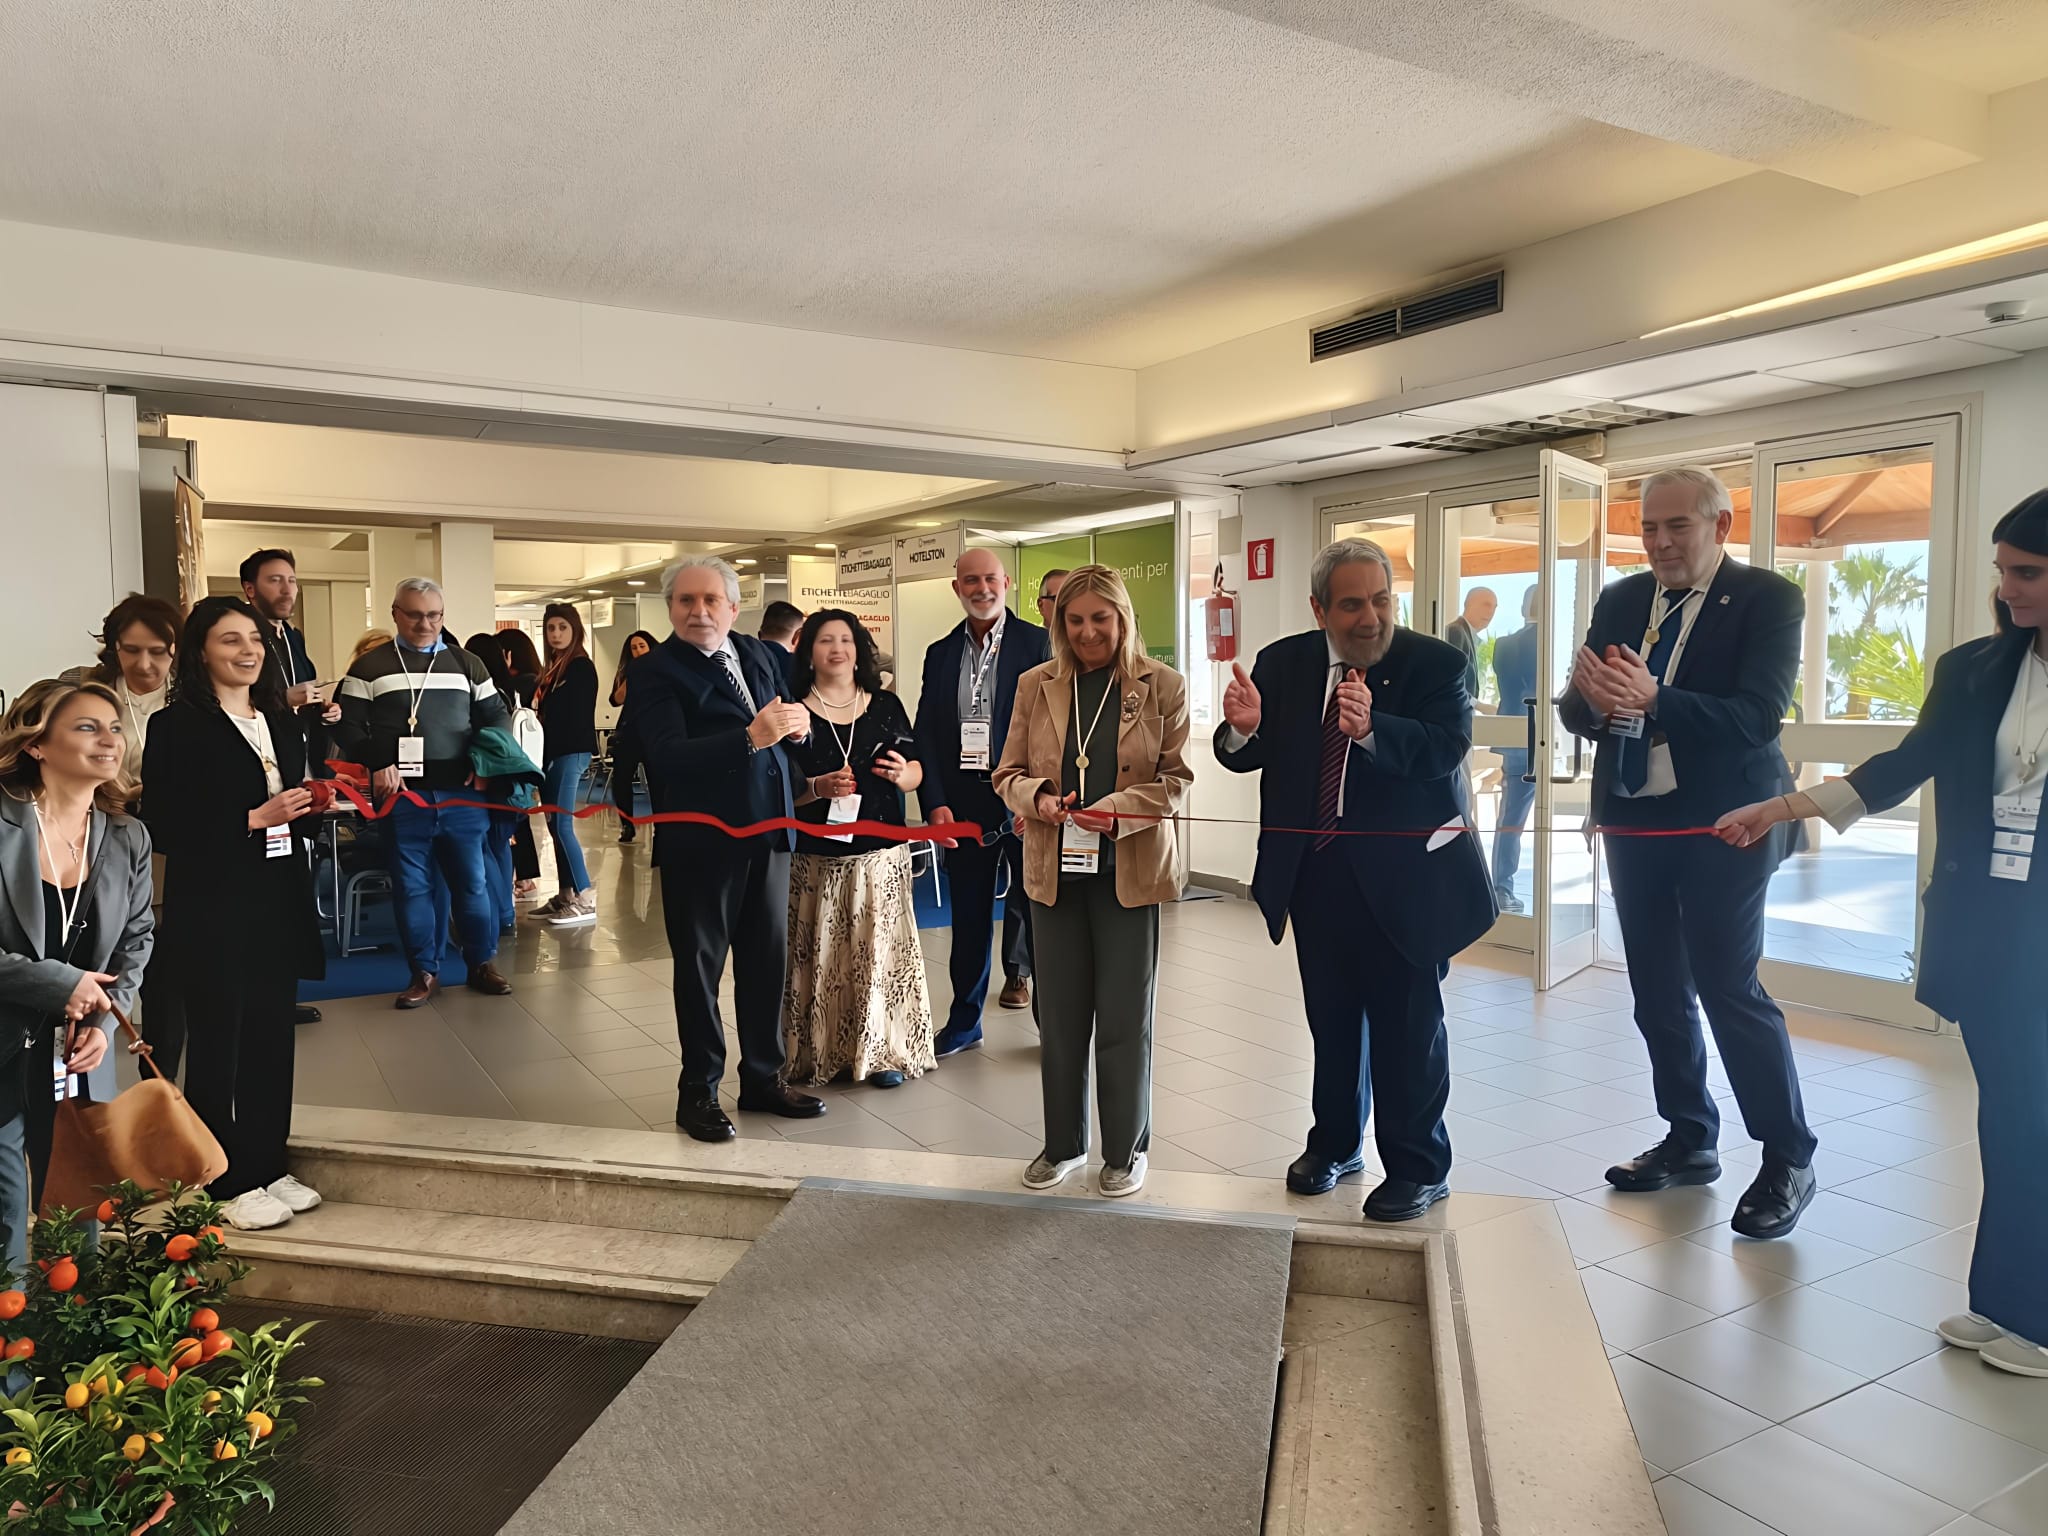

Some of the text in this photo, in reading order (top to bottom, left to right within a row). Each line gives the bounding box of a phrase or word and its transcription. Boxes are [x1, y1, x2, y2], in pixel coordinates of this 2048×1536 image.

[909, 548, 945, 564] HOTELSTON
[841, 557, 892, 574] ETICHETTEBAGAGLIO
[1147, 562, 1168, 582] per
[801, 588, 890, 599] ETICHETTEBAGAGLIO
